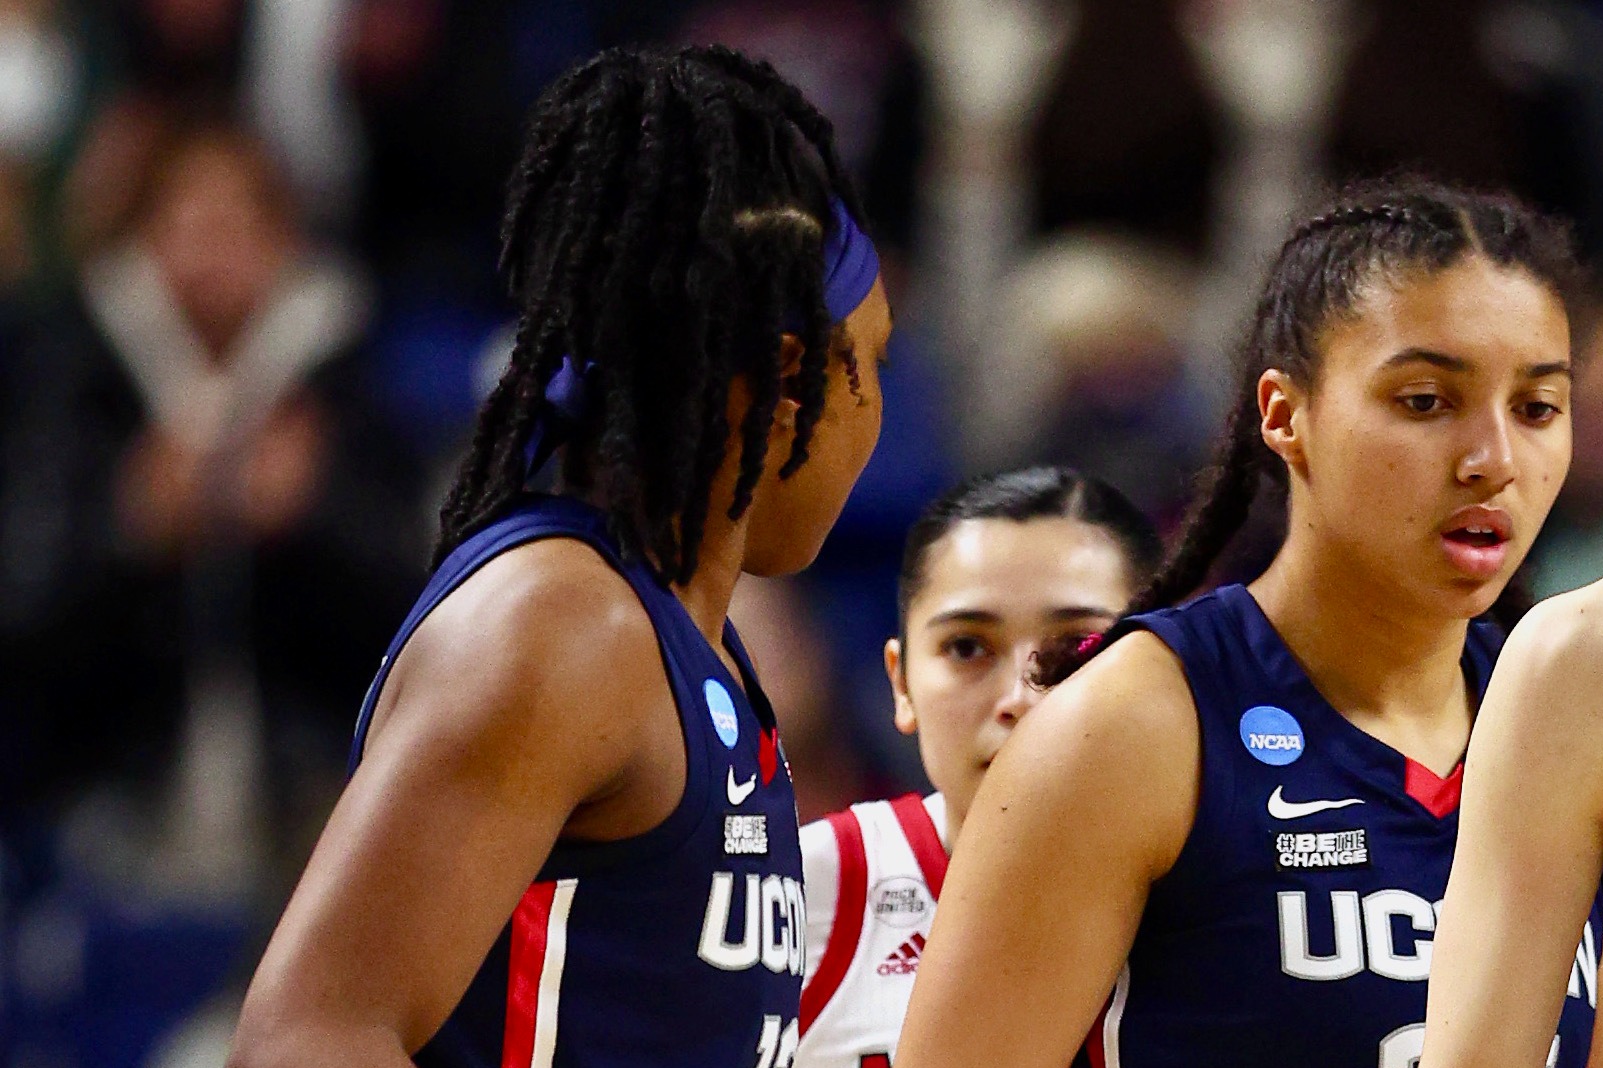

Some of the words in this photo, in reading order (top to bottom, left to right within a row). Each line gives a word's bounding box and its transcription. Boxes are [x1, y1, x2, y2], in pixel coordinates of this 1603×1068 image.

[1250, 733, 1301, 750] NCAA
[1279, 849, 1367, 868] CHANGE
[697, 872, 806, 976] UCO
[1277, 889, 1598, 1009] UCN
